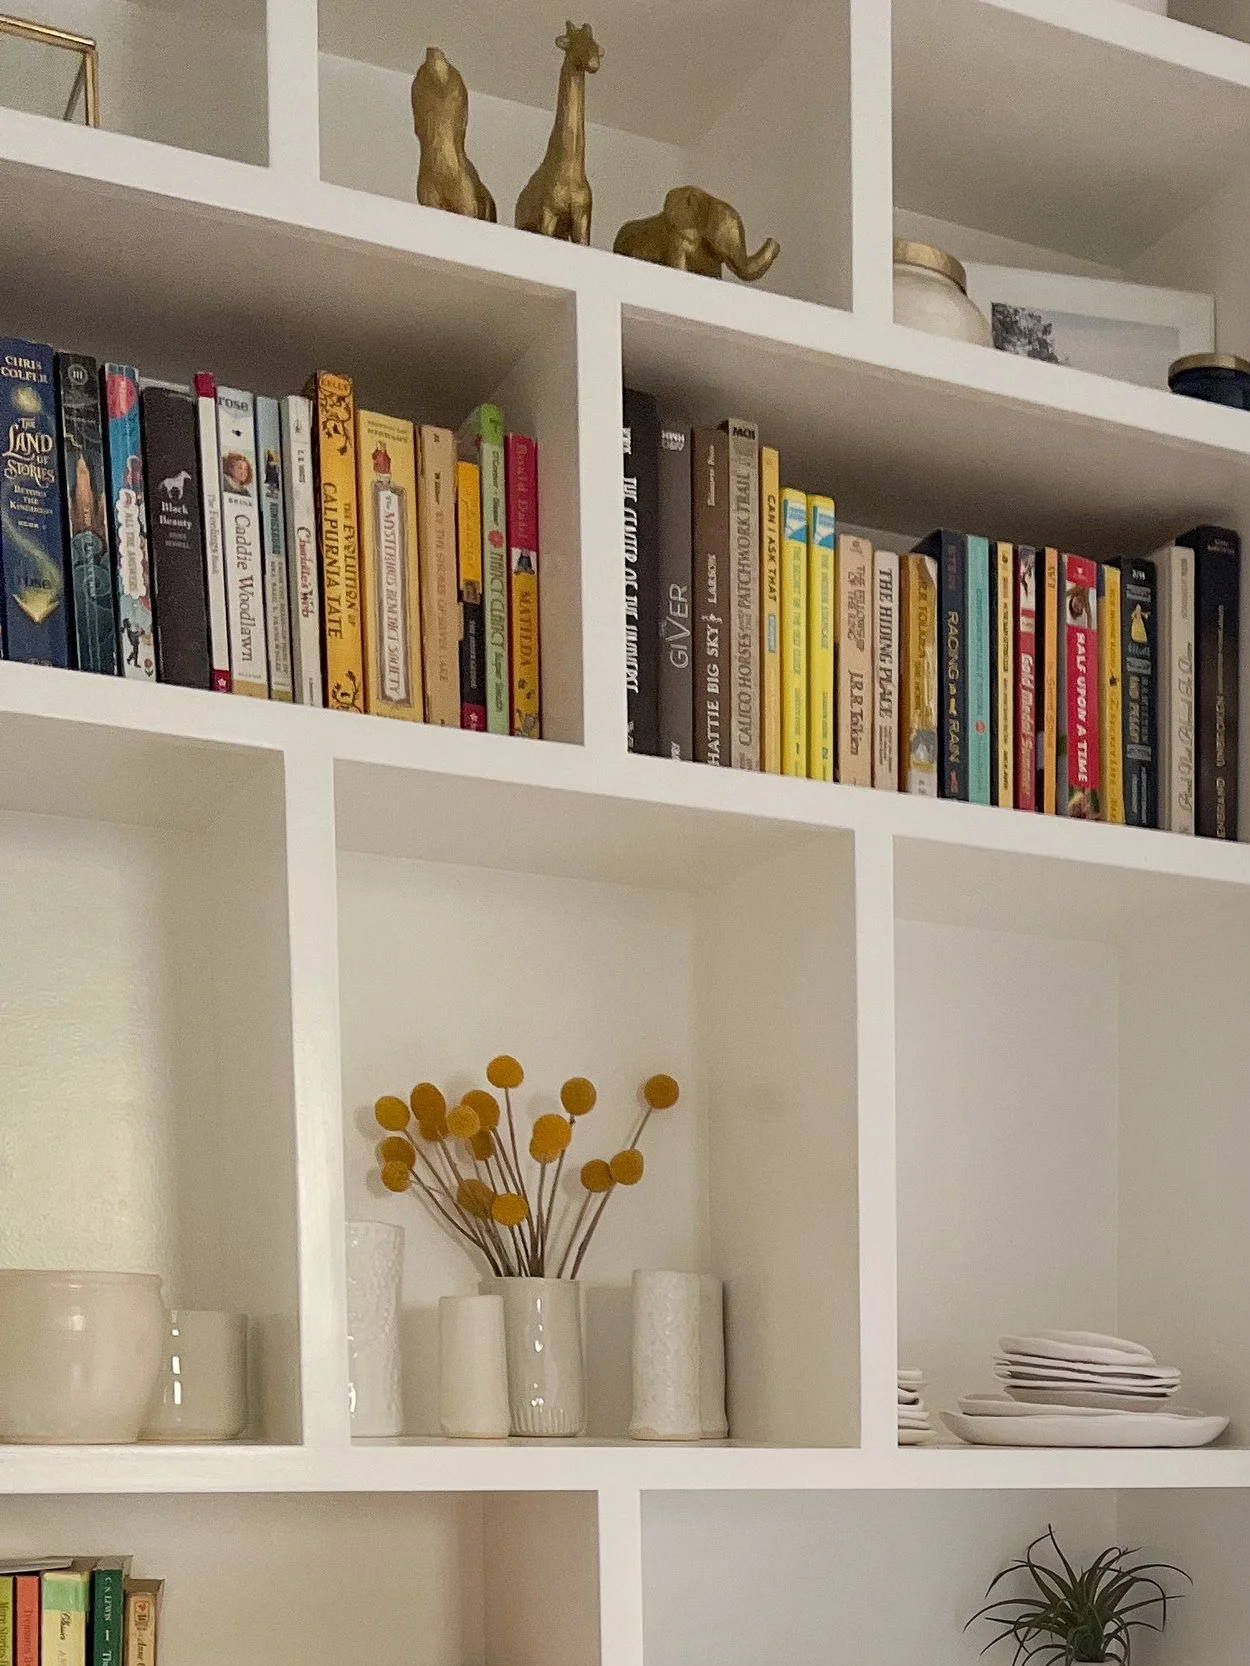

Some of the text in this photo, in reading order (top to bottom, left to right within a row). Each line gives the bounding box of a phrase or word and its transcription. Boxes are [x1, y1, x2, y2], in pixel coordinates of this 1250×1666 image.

[0, 367, 48, 383] COLFER
[5, 356, 43, 371] CHRIS
[20, 418, 36, 430] THE
[219, 397, 249, 413] rose
[3, 424, 53, 462] LAND
[4, 460, 55, 488] STORIES
[123, 512, 135, 528] ALL
[160, 515, 193, 531] Beauty
[161, 502, 188, 516] Black
[343, 503, 352, 520] THE
[767, 495, 776, 526] CAN
[208, 510, 220, 554] Feelings
[384, 511, 398, 586] MYSTERIOUS
[768, 537, 776, 564] ASK
[297, 527, 314, 617] Charlotte's Web
[322, 482, 342, 640] CALPURNIA TATE
[343, 524, 357, 608] EVOLUTION
[515, 445, 534, 667] Roald Dahl MATILDA
[794, 547, 802, 562] THE
[234, 514, 256, 661] Caddie Woodlawn
[708, 553, 717, 603] LARSON
[768, 568, 777, 603] THAT
[794, 564, 802, 594] SECRET
[879, 568, 893, 604] THE
[386, 590, 400, 642] BENEDICT
[491, 551, 505, 650] NANCY CLANCY
[735, 472, 752, 746] CALICO HORSES PATCHWORK TRAIL
[821, 554, 829, 651] THE HIDDEN STAIRCASE
[848, 590, 857, 612] THE
[856, 565, 866, 652] THE FELLOWSHIP
[663, 582, 688, 668] GIVER
[794, 630, 802, 646] OLD
[848, 614, 857, 640] KING
[879, 605, 893, 665] HIDING
[387, 645, 401, 694] SOCIETY
[494, 652, 504, 712] Super Sleuth
[794, 649, 802, 676] CLOCK
[706, 626, 721, 763] HATTIE BIG SKY
[879, 667, 893, 720] PLACE
[948, 611, 960, 762] RACING RAIN
[847, 669, 864, 757] J.R.R. Tolkien
[1020, 653, 1034, 797] Gold Medal Summer
[1076, 632, 1088, 783] HALF UPON A TIME
[60, 1612, 72, 1641] Classics
[104, 1594, 113, 1621] LEWIS
[135, 1637, 146, 1661] Anne
